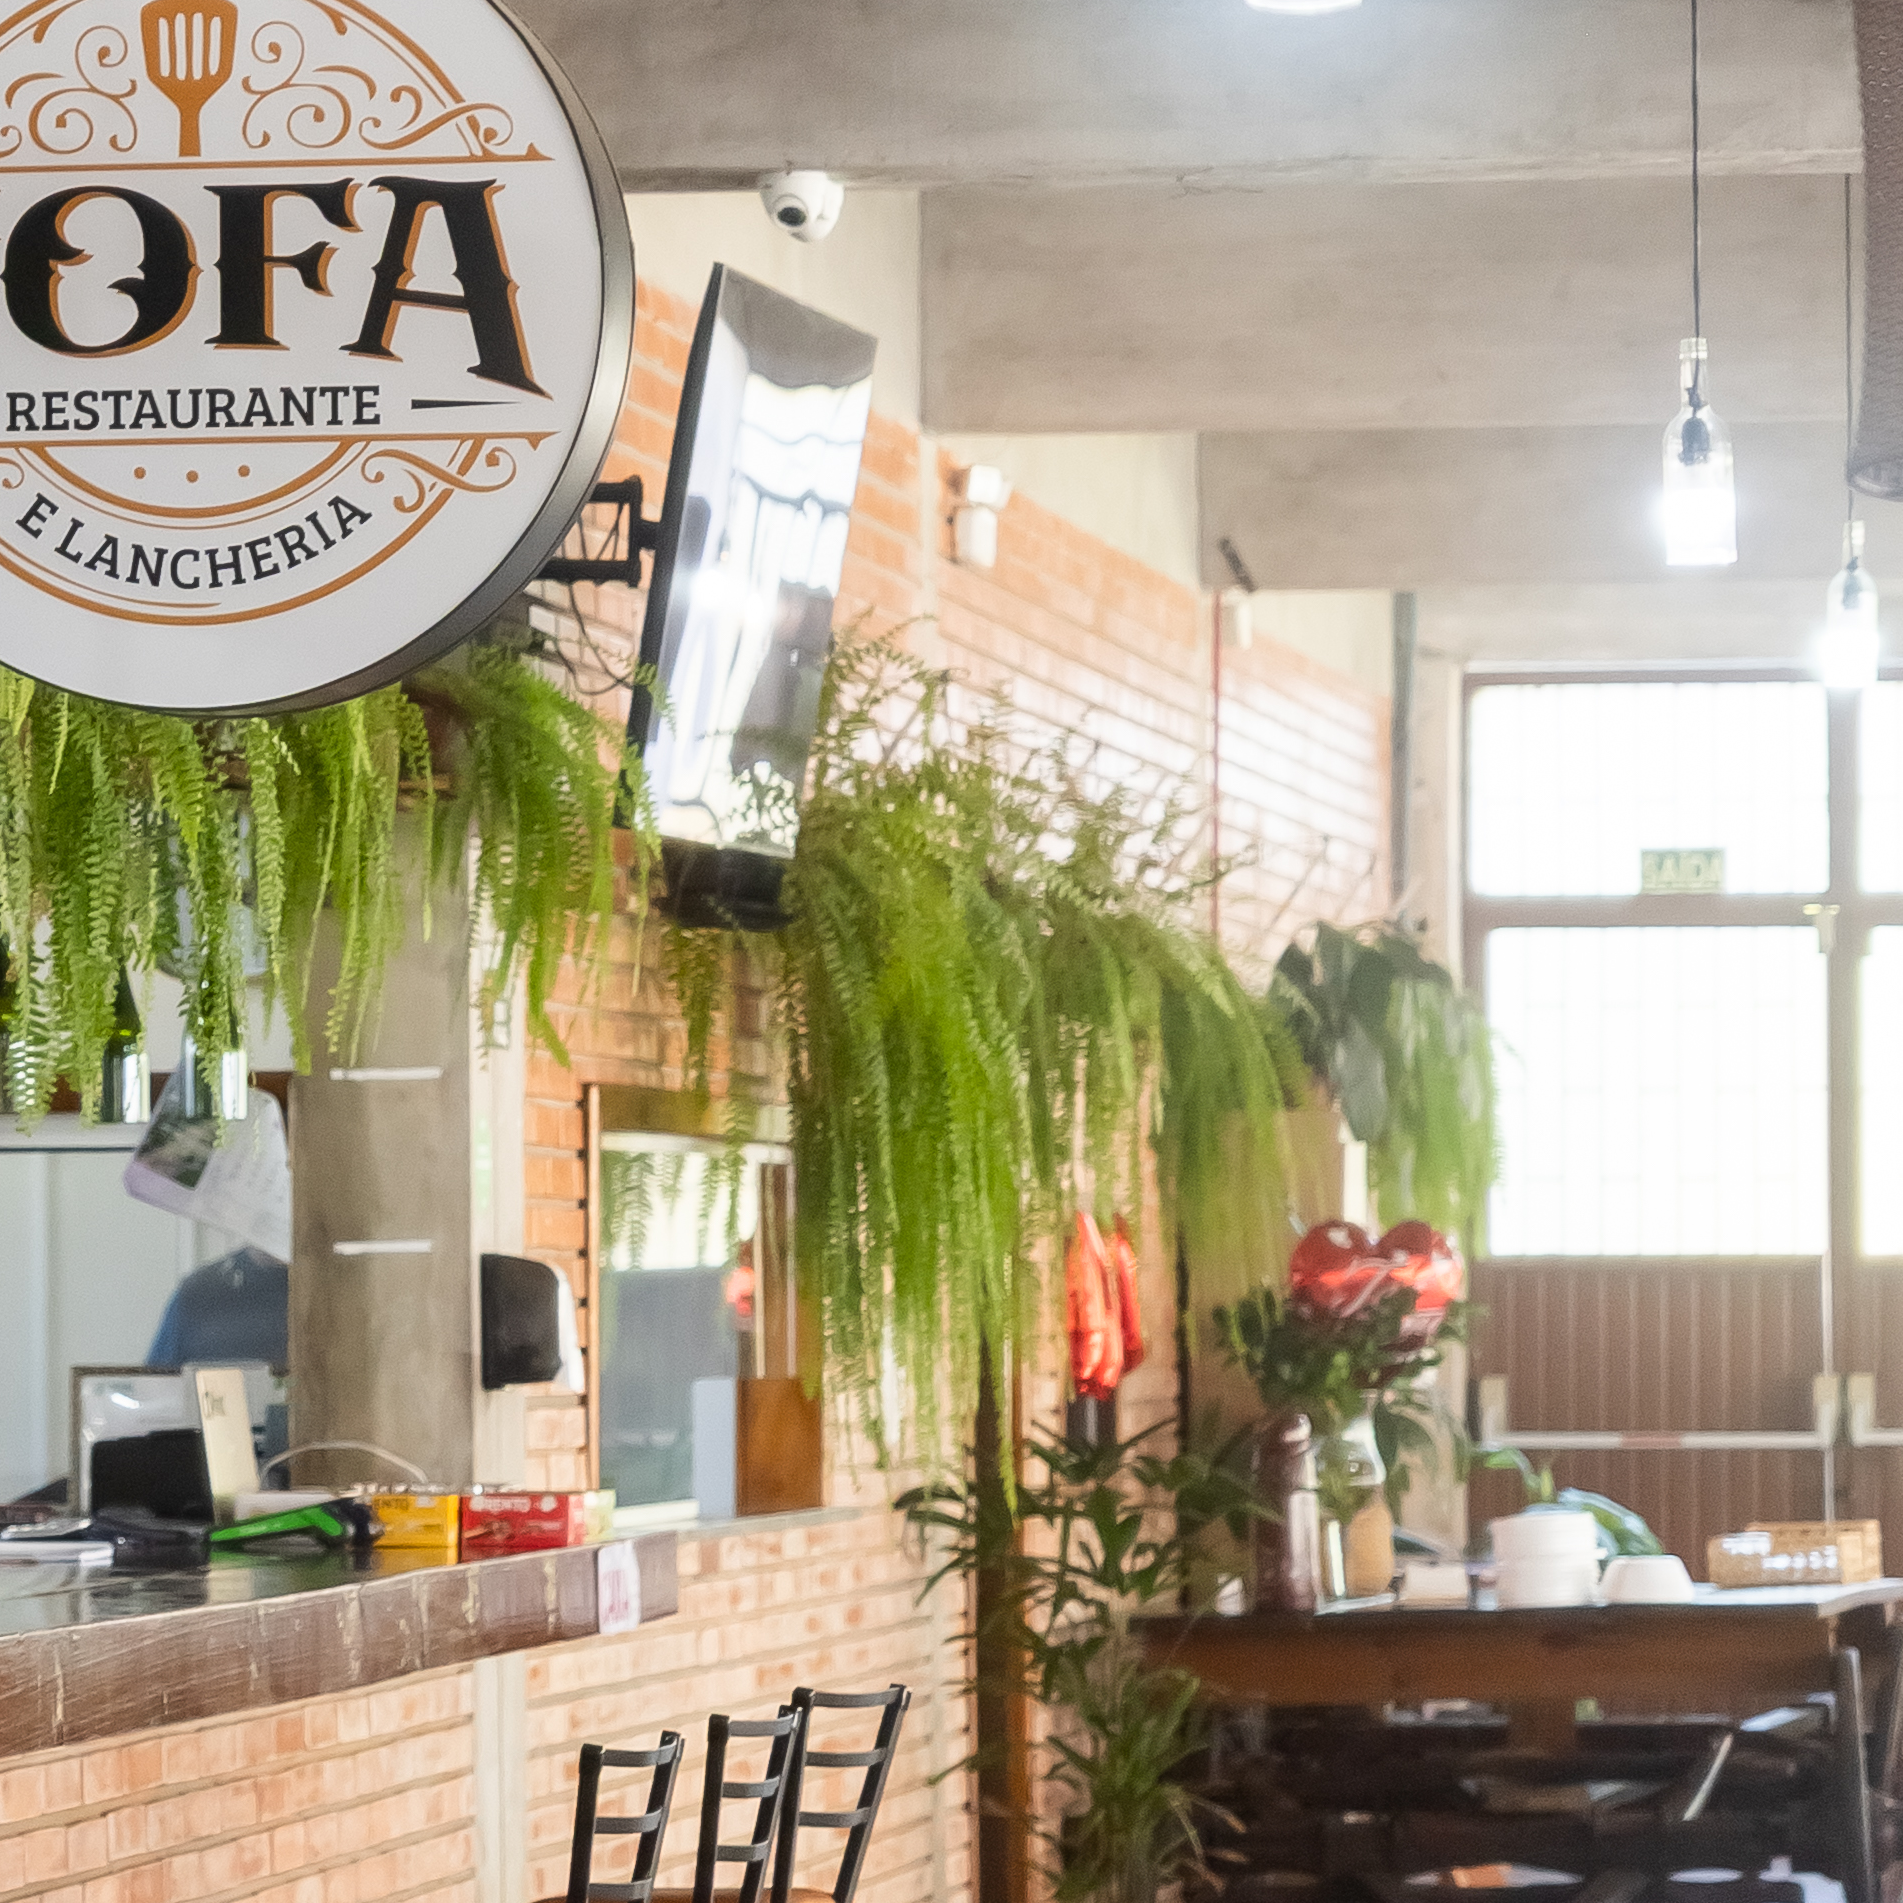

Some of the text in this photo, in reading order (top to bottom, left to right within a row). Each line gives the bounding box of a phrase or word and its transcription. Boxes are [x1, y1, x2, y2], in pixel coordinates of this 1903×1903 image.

[6, 386, 381, 432] RESTAURANTE
[15, 492, 373, 590] E LANCHERIA
